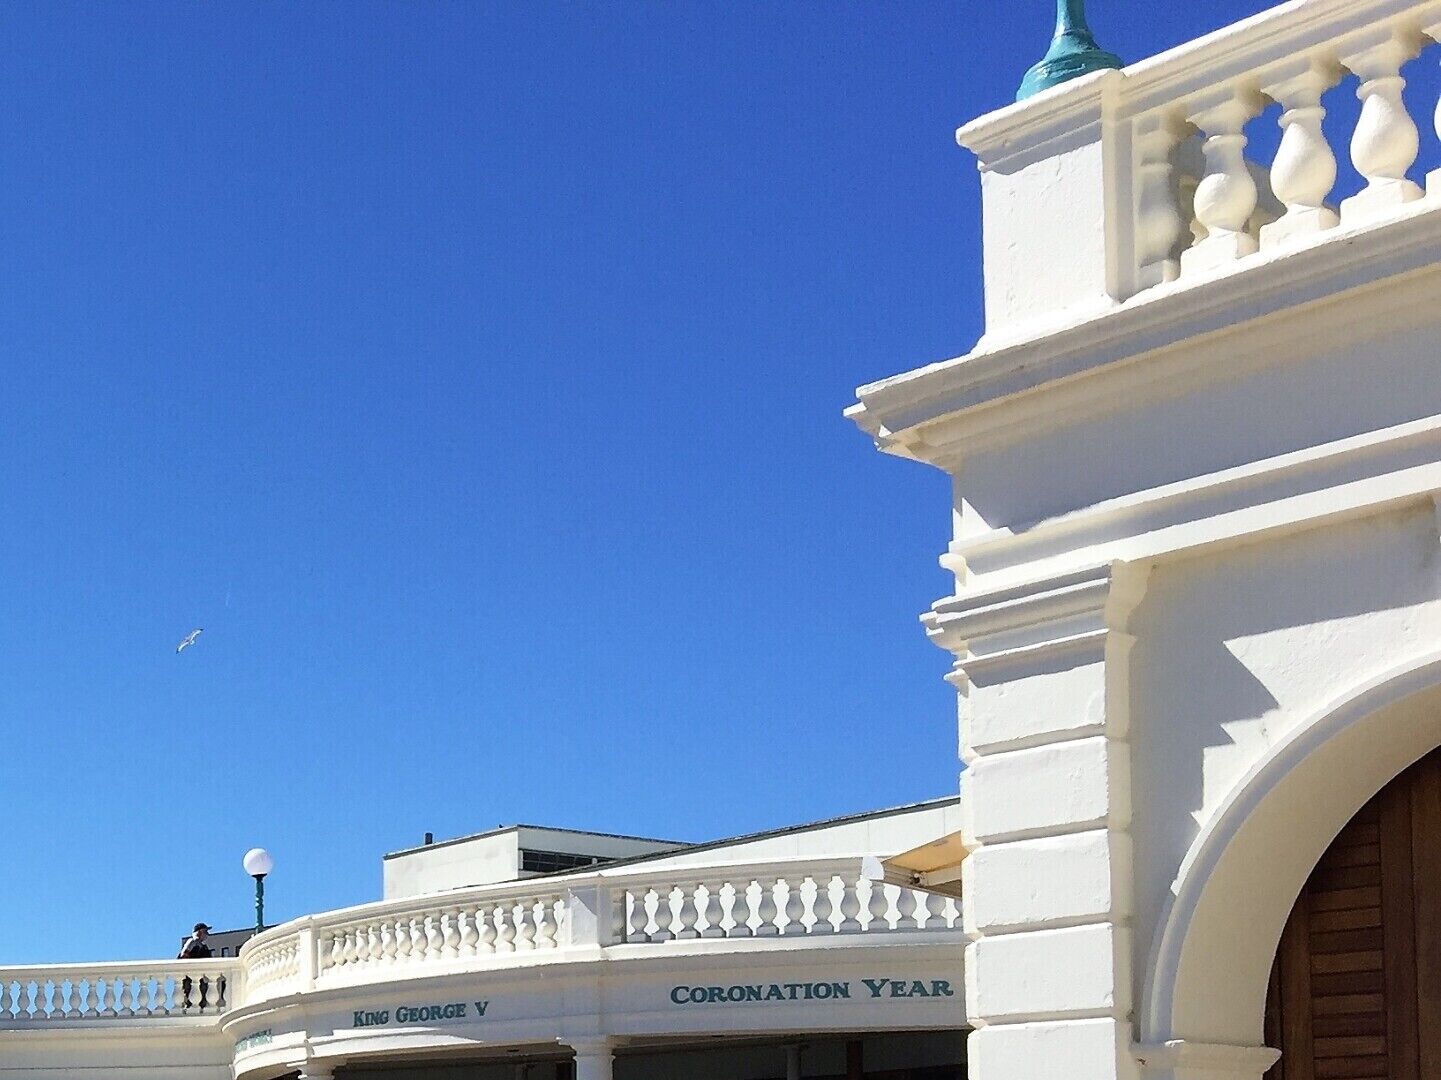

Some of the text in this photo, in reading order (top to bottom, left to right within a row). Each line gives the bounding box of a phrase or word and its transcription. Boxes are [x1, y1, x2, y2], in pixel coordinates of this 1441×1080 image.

[669, 978, 954, 1005] CORONATION YEAR
[352, 1001, 489, 1027] KING GEORGE V
